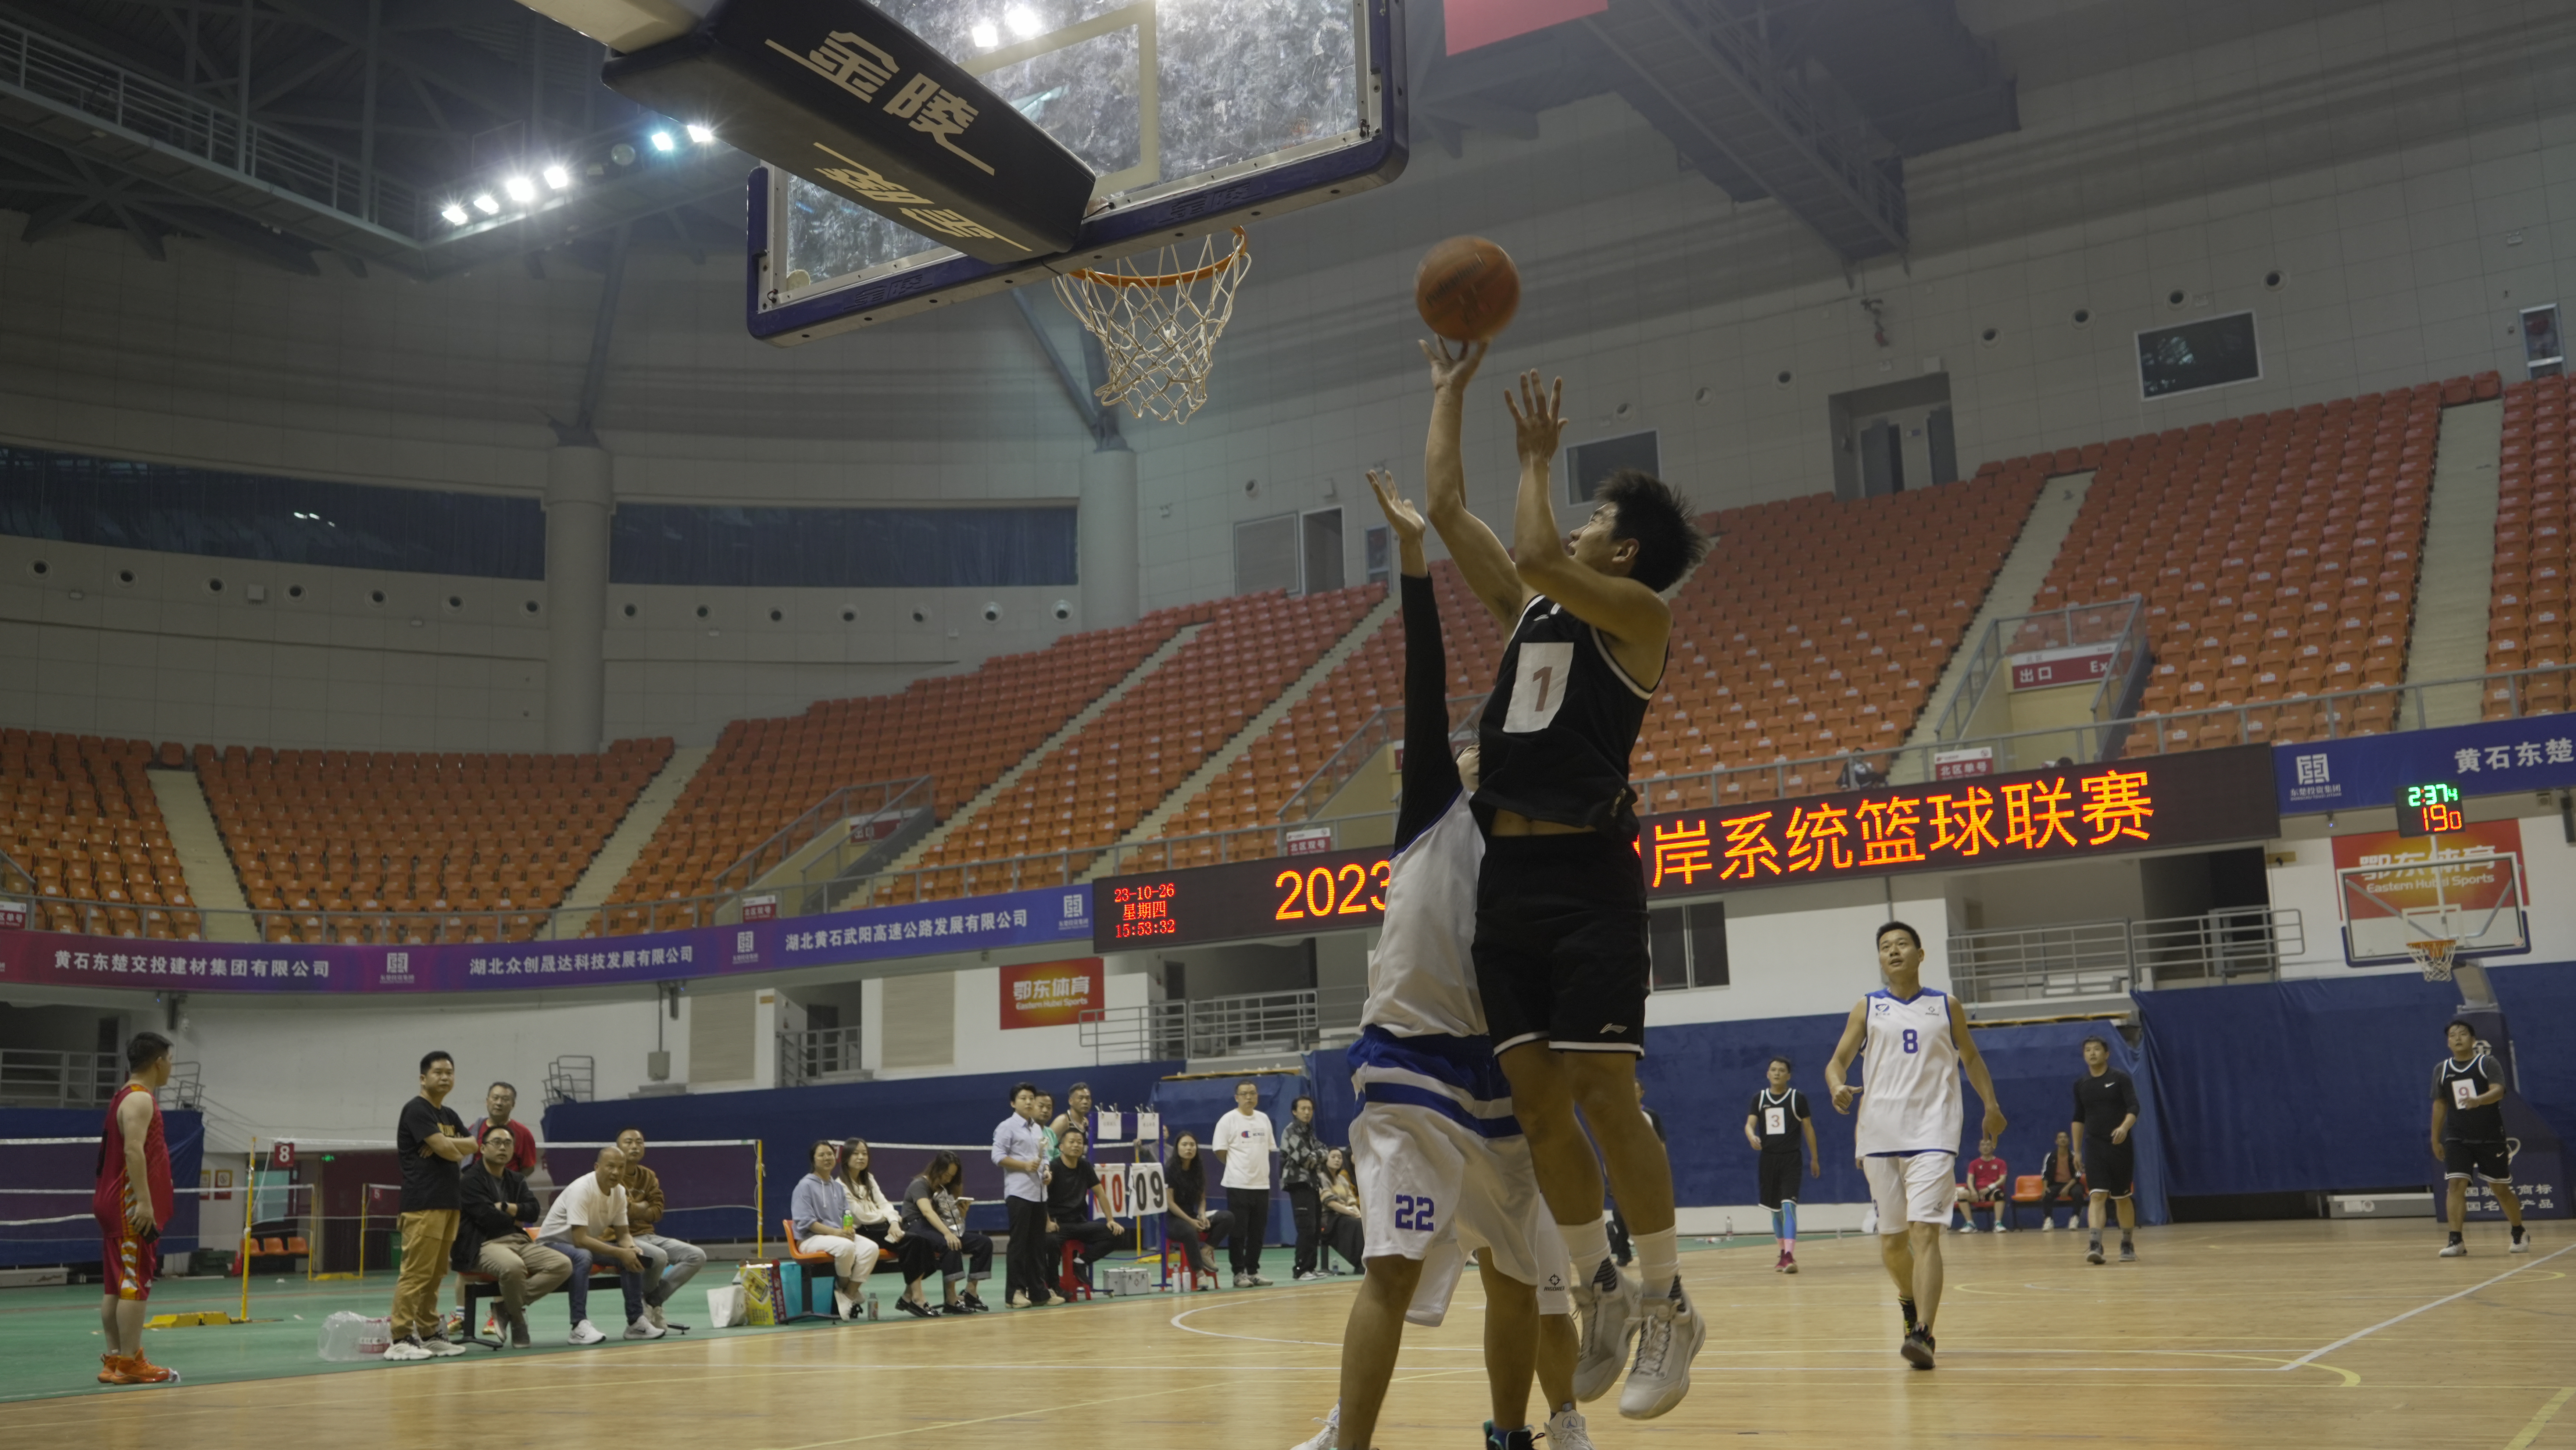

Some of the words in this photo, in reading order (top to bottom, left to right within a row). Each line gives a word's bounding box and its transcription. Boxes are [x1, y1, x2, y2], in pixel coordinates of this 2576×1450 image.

[765, 30, 995, 176] 金陵
[2020, 666, 2052, 683] 出口
[2090, 658, 2112, 674] Ex
[1533, 667, 1553, 711] 1
[2454, 737, 2575, 774] 黄石东楚
[1940, 761, 1987, 776] 北区单号
[2290, 783, 2341, 797] 东楚投资集团
[1275, 860, 1391, 920] 2023
[1632, 769, 2155, 888] 岸系统篮球联赛
[1290, 839, 1325, 852] 北区双号
[1114, 883, 1175, 903] 23-10-26
[2366, 881, 2413, 893] Eastern
[2452, 873, 2495, 888] Sports
[1122, 900, 1167, 921] 星期四
[785, 909, 1028, 952] 湖北黄石武阳高速公路发展有限公司
[1116, 919, 1176, 938] 15:53:32
[55, 950, 330, 978] 黄石东楚交投建材集团有限公司
[470, 946, 693, 976] 湖北众创晟达科技发展有限公司
[1013, 976, 1090, 1000] 鄂东体育
[1016, 1001, 1043, 1010] Eastern
[1063, 997, 1088, 1007] Sports
[1903, 1028, 1919, 1054] 8
[1771, 1114, 1780, 1128] 3
[279, 1145, 290, 1163] 8
[1135, 1171, 1164, 1212] 09
[1395, 1194, 1434, 1232] 22
[2466, 1199, 2554, 1212] 国名产品
